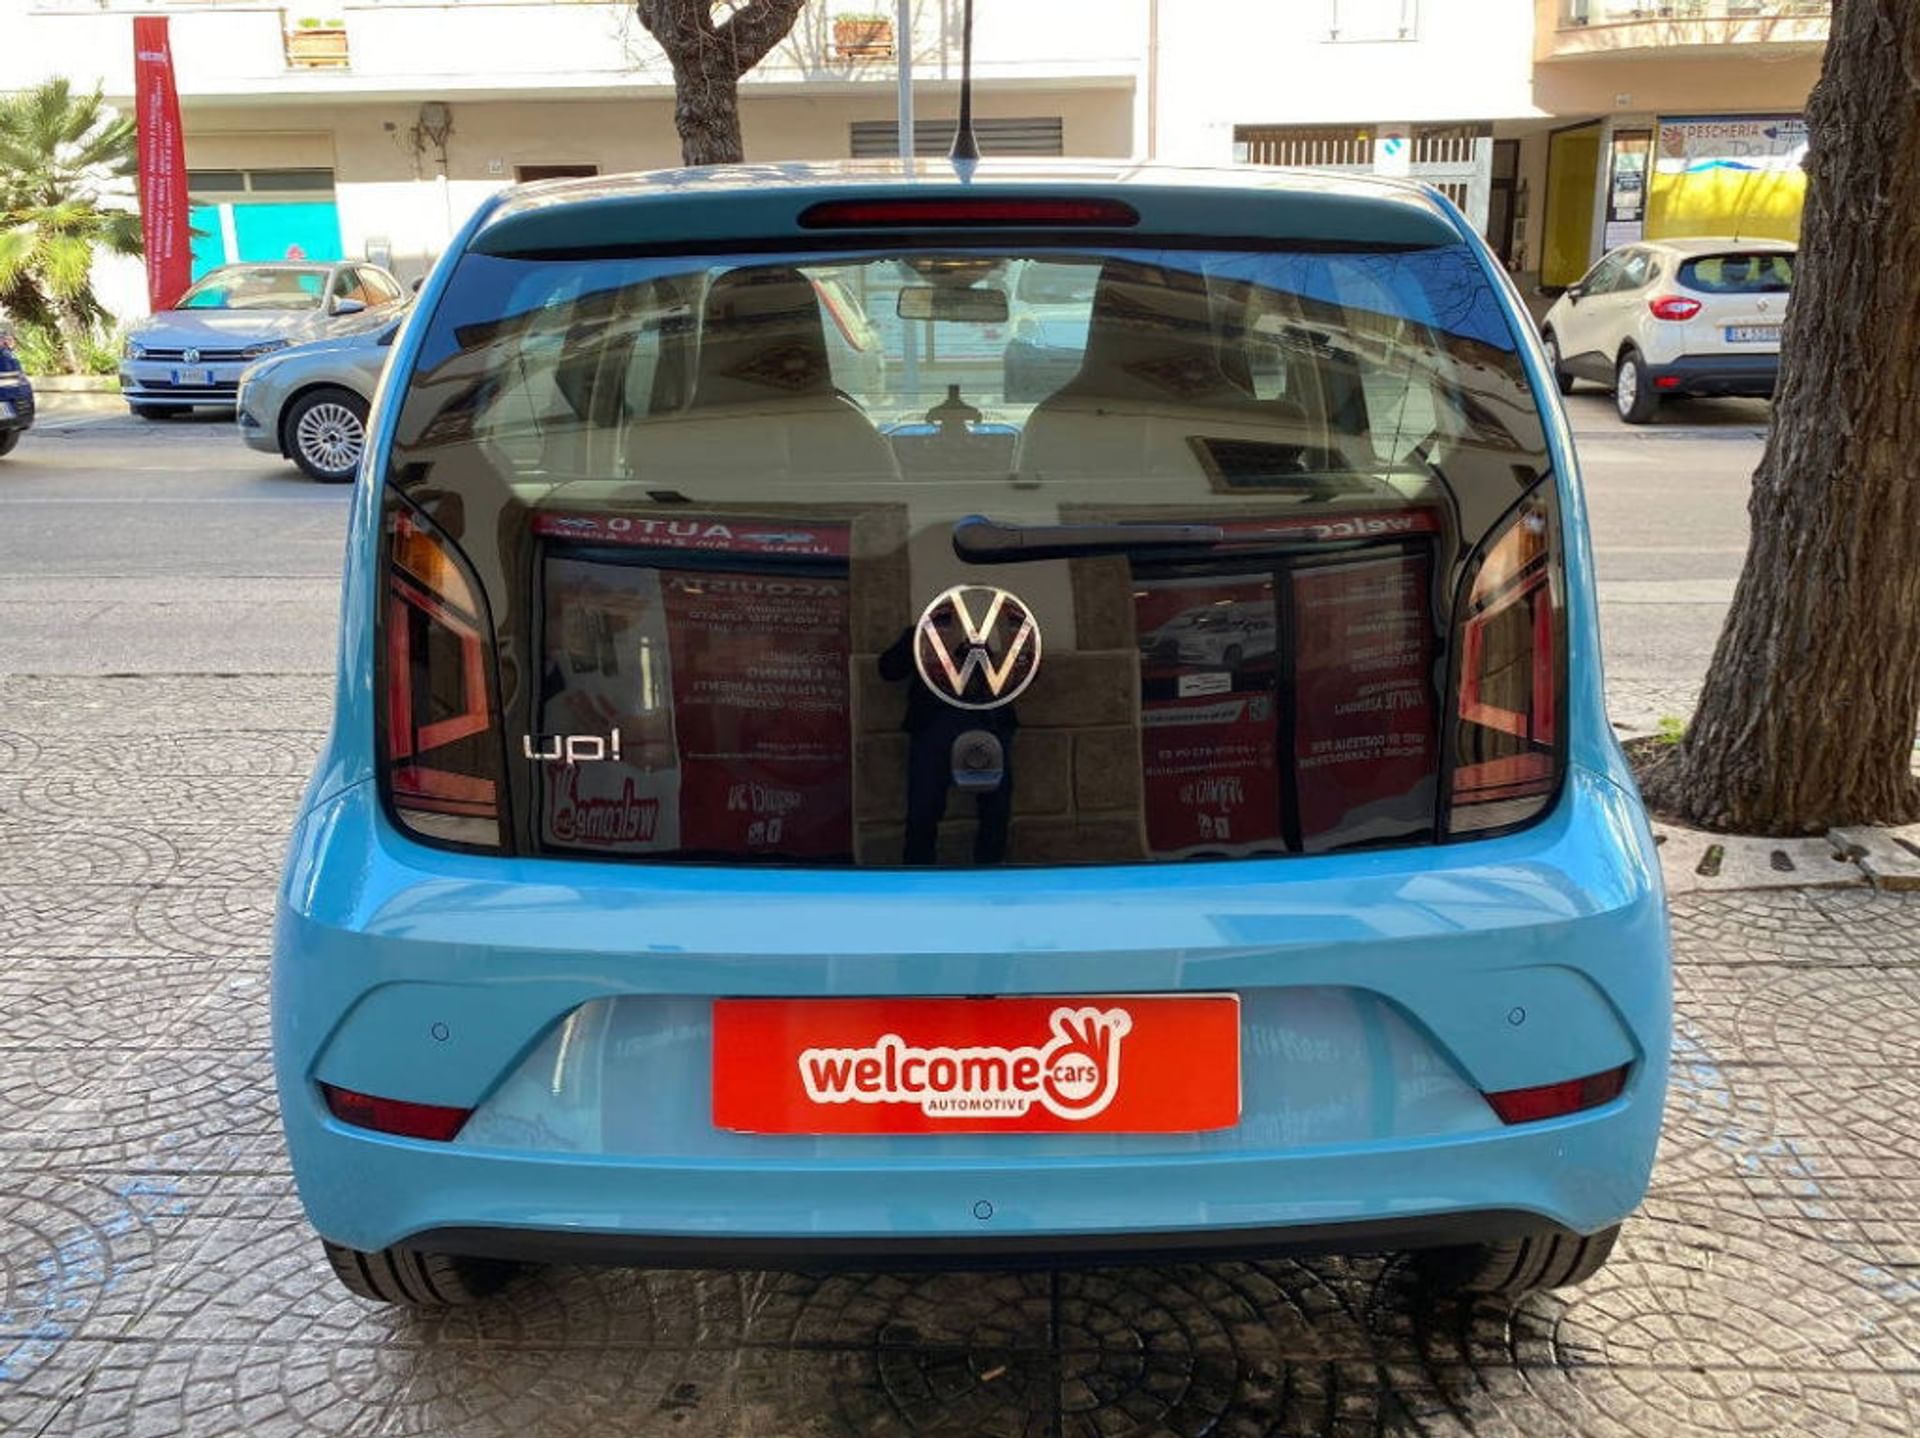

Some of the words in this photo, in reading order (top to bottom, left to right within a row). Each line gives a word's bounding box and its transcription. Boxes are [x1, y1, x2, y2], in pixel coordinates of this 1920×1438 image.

[1687, 124, 1760, 139] PESCHERIA
[523, 727, 620, 764] up!
[808, 1045, 1041, 1093] welcome
[1053, 1064, 1097, 1083] cars
[928, 1098, 1026, 1112] AUTOMOTIVE
